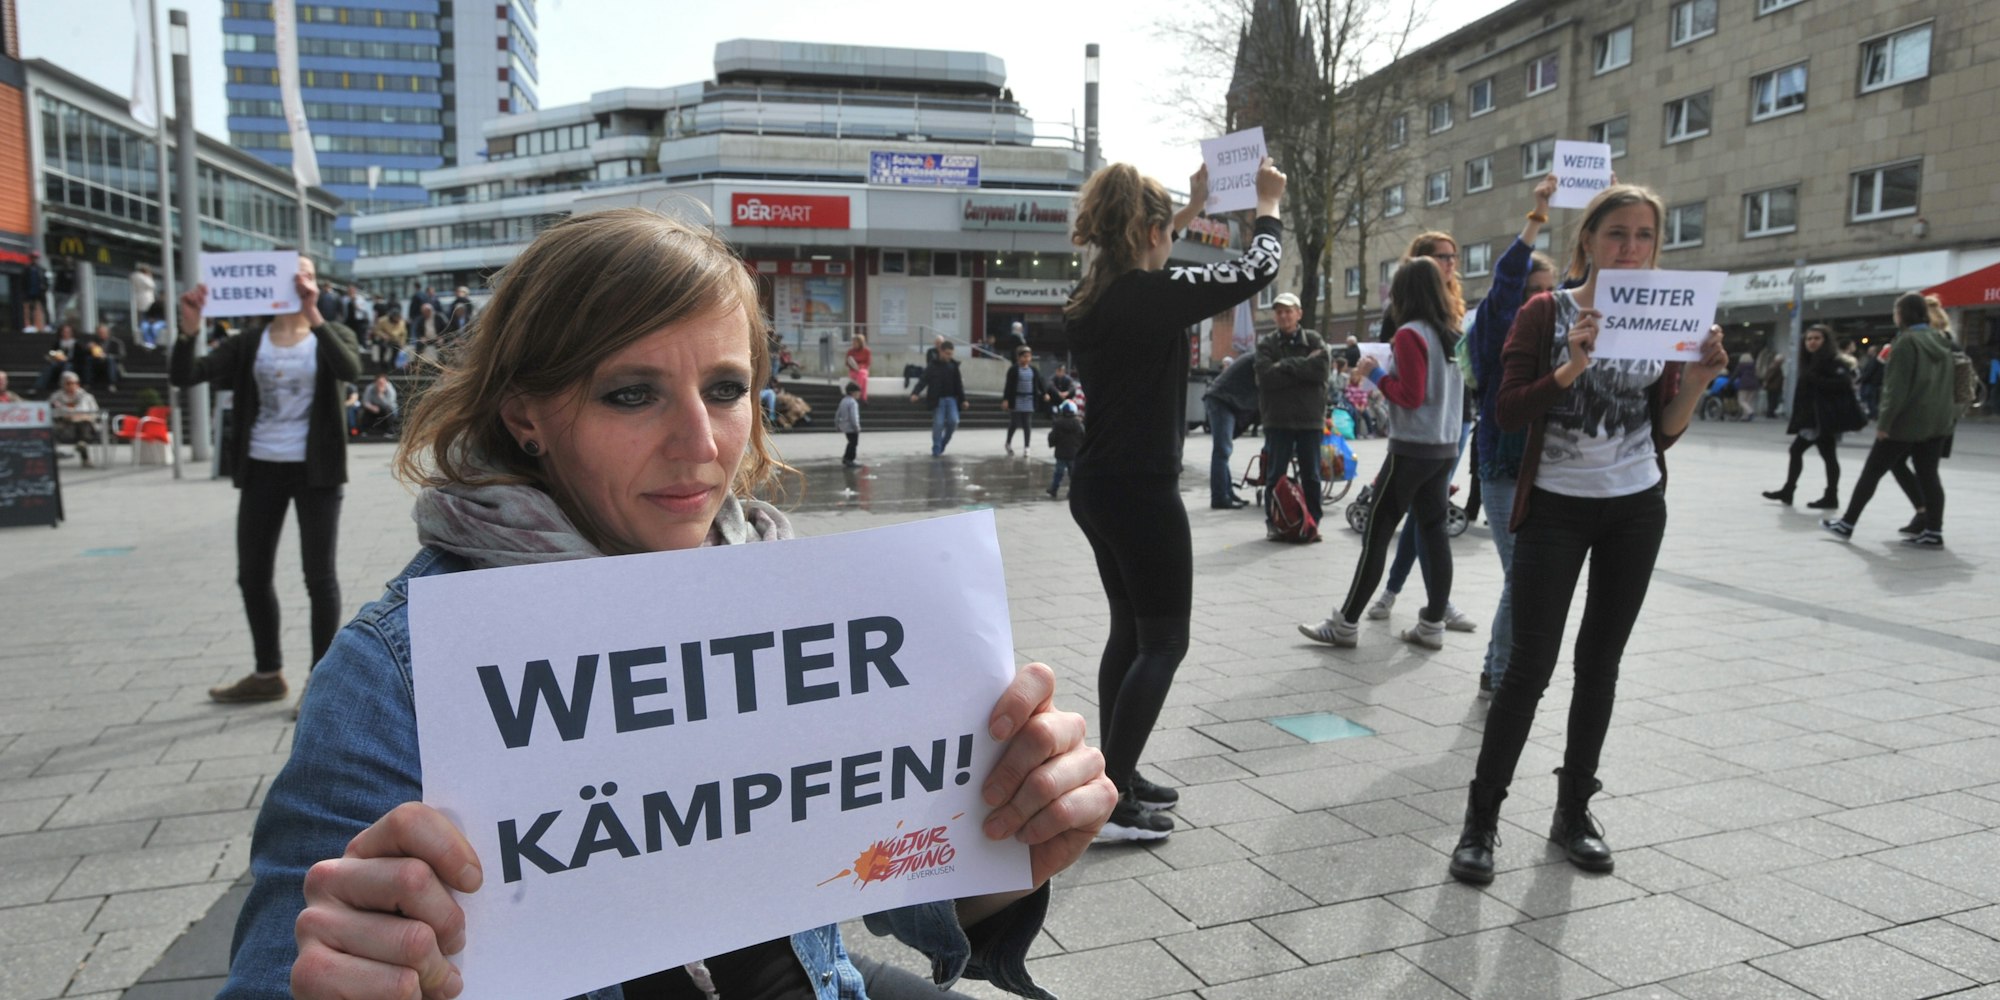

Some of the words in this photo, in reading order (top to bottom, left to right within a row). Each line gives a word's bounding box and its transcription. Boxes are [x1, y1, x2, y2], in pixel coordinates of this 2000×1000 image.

[1563, 155, 1606, 169] WEITER
[1018, 201, 1027, 221] &
[210, 264, 277, 278] WEITER
[212, 286, 274, 300] LEBEN!
[995, 286, 1048, 298] Currywurst
[1051, 287, 1058, 296] &
[1610, 286, 1695, 306] WEITER
[1605, 315, 1699, 333] SAMMELN!
[476, 615, 910, 749] WEITER
[497, 733, 973, 883] KÄMPFEN!
[869, 826, 949, 866] KULTUR
[860, 843, 955, 891] RETTUNG
[907, 865, 955, 881] LEVERKUSEN
